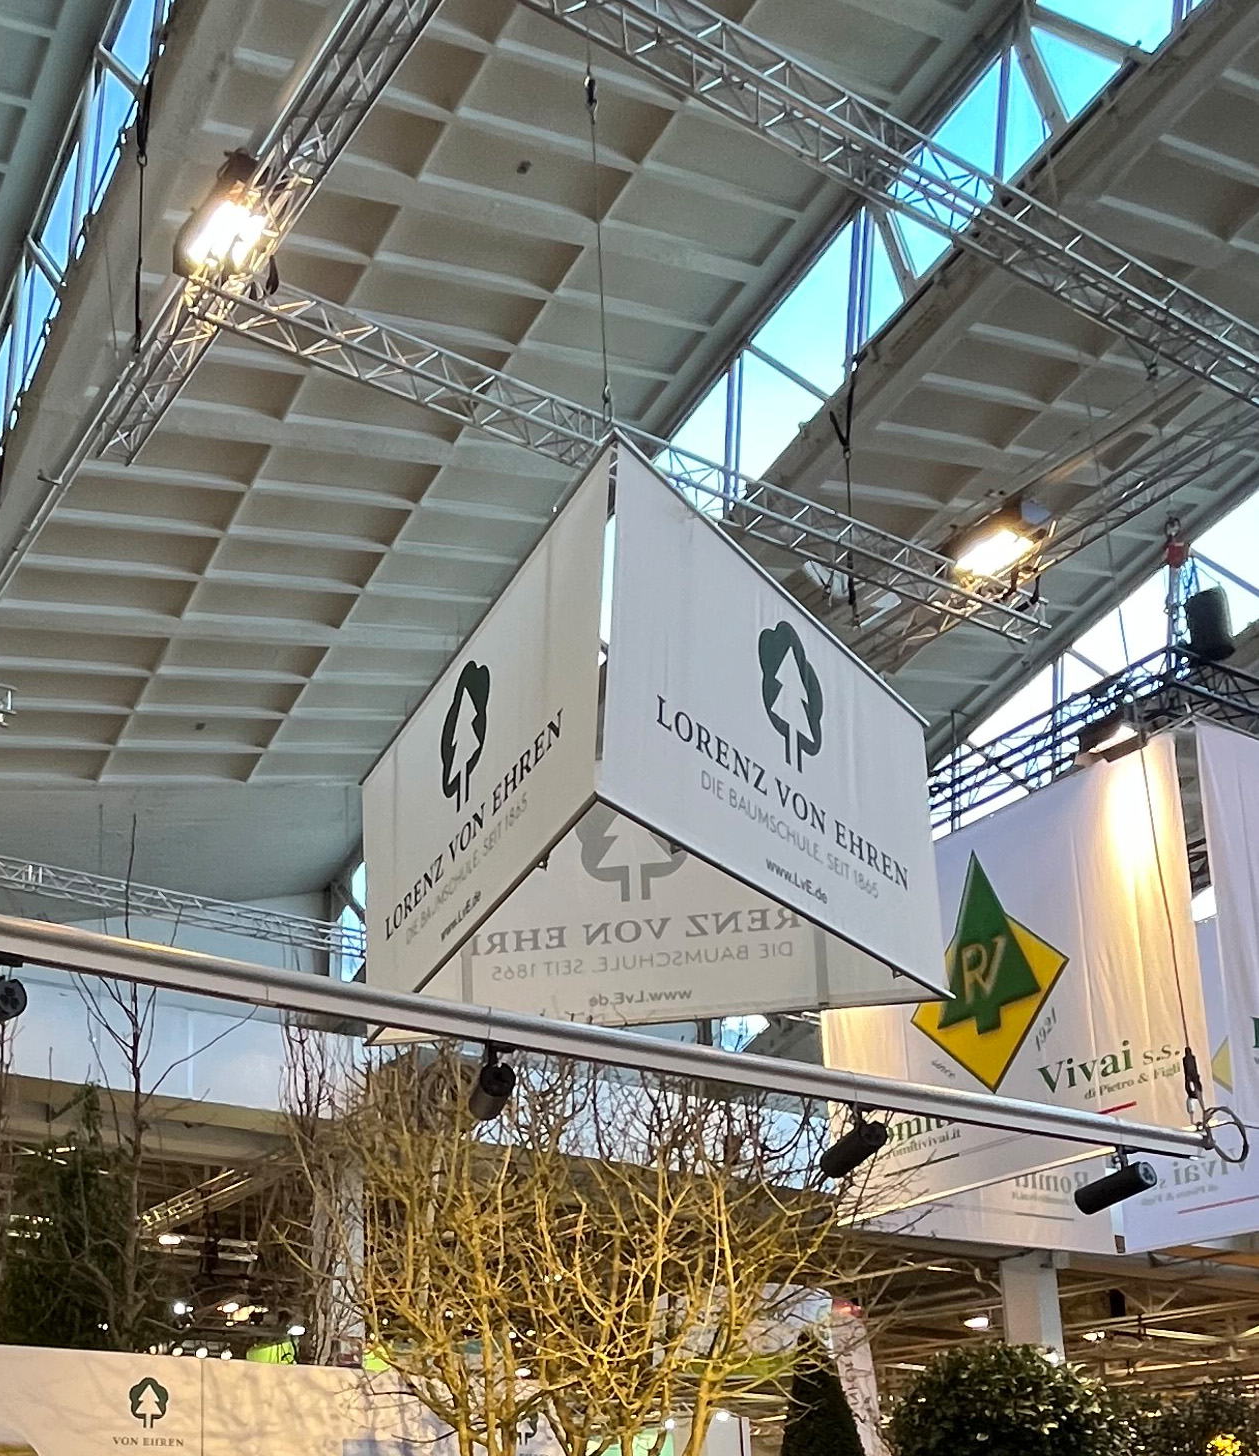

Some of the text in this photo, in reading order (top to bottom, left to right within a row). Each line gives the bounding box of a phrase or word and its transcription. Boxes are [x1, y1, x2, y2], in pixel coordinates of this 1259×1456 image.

[656, 694, 909, 891] LORENZ VON EHREN
[385, 708, 563, 941] LORENZ VON EHREN
[701, 770, 723, 800] DIE
[827, 852, 850, 878] SEIT
[854, 870, 879, 899] 1865
[766, 858, 828, 905] www.LvE.de
[1035, 1006, 1058, 1052] 1921
[931, 1058, 956, 1079] since
[1037, 1040, 1180, 1094] Vivai s.s.
[1099, 1080, 1135, 1097] Pietro
[1137, 1073, 1149, 1085] &
[113, 1436, 184, 1447] VON EHREN
